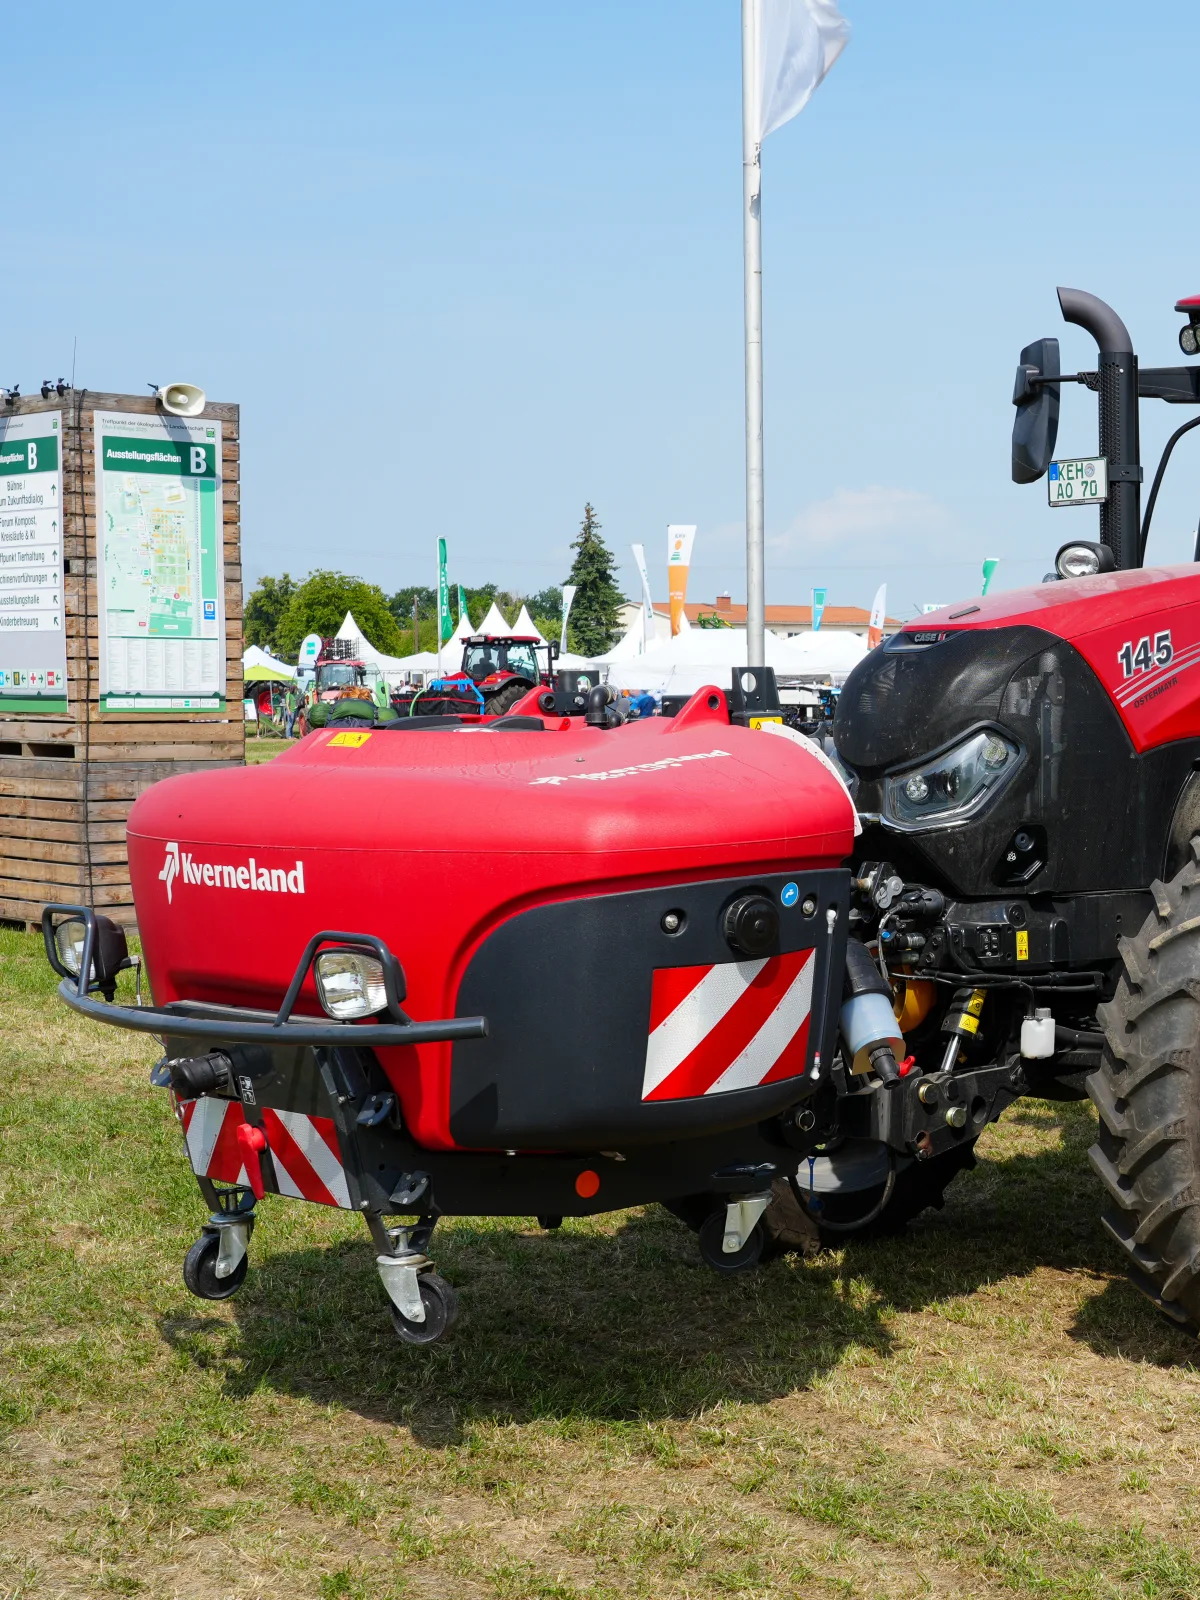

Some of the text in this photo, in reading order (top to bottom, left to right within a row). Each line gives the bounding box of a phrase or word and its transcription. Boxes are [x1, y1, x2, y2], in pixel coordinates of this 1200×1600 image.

[27, 442, 38, 470] B
[106, 448, 182, 464] Ausstellungsflächen
[189, 446, 207, 474] B
[1058, 462, 1084, 481] KEH
[7, 480, 22, 491] Bühne
[1081, 480, 1098, 497] 70
[7, 494, 44, 506] Zukunftsdialog
[17, 551, 45, 562] Tierhaltung
[914, 633, 936, 643] CASE
[1117, 628, 1174, 679] 145
[1133, 677, 1178, 709] OSTERMAYR
[180, 852, 305, 894] Kverneland
